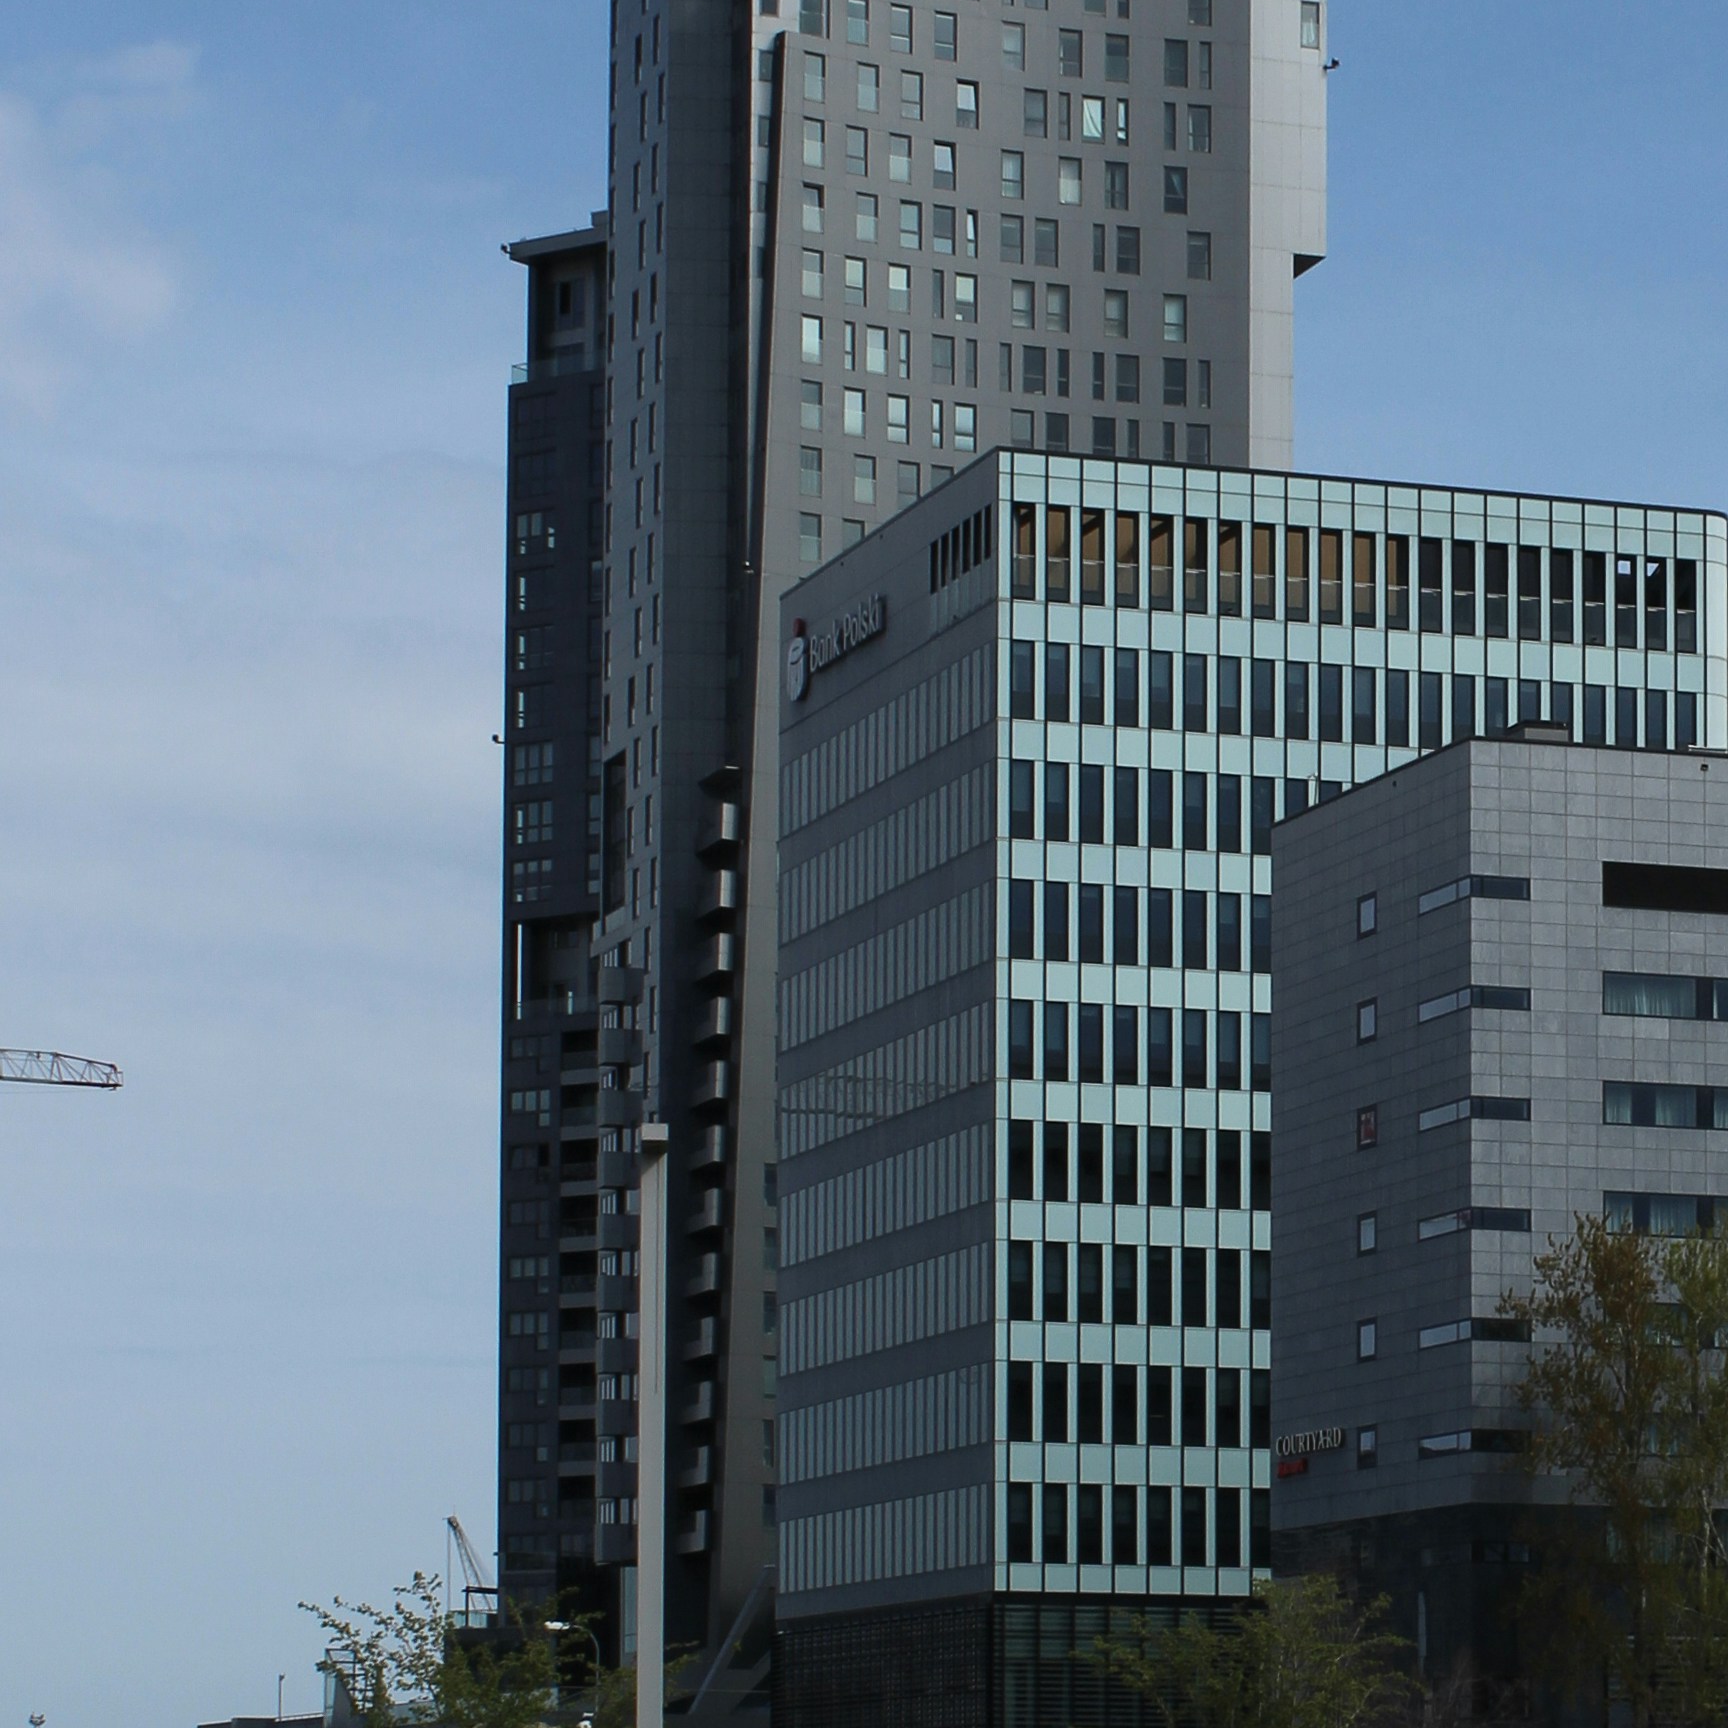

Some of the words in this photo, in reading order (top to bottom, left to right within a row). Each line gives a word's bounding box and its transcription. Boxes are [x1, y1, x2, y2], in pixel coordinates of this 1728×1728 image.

[809, 619, 840, 673] Bank
[843, 592, 880, 651] Polski
[1275, 1427, 1342, 1456] COURTYARD
